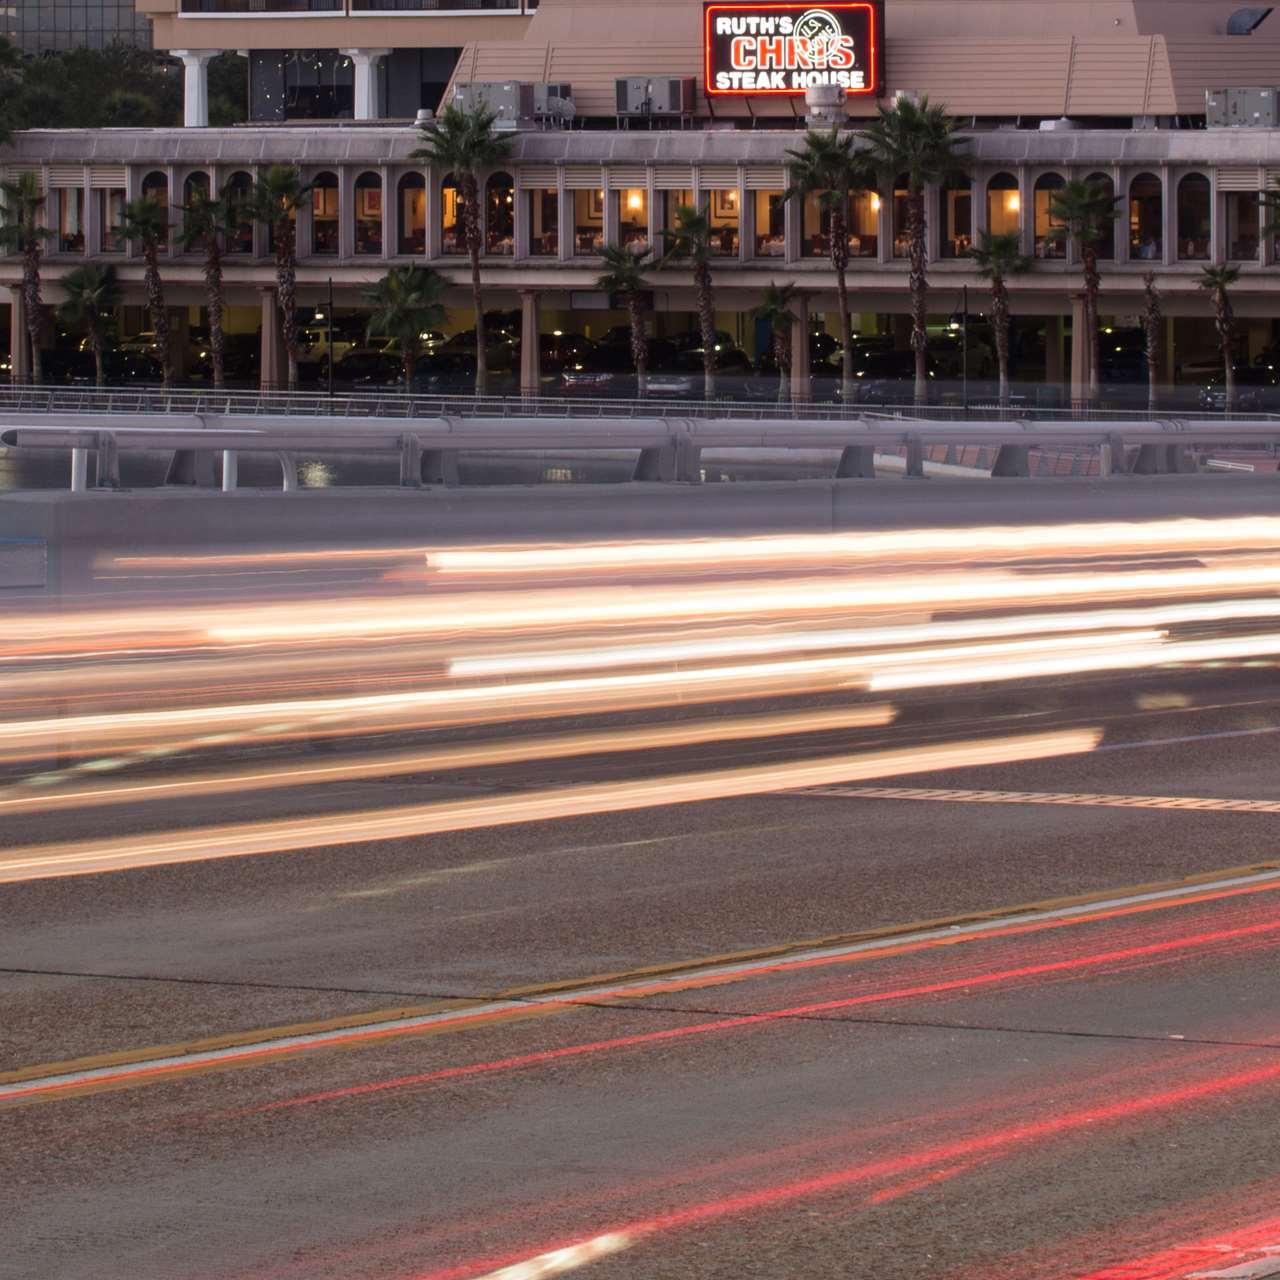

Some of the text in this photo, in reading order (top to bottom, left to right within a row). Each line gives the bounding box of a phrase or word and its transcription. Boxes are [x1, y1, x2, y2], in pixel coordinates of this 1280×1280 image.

[716, 16, 794, 35] RUTH'S
[731, 36, 856, 70] CHRIS
[716, 70, 865, 89] STEAK HOUSE
